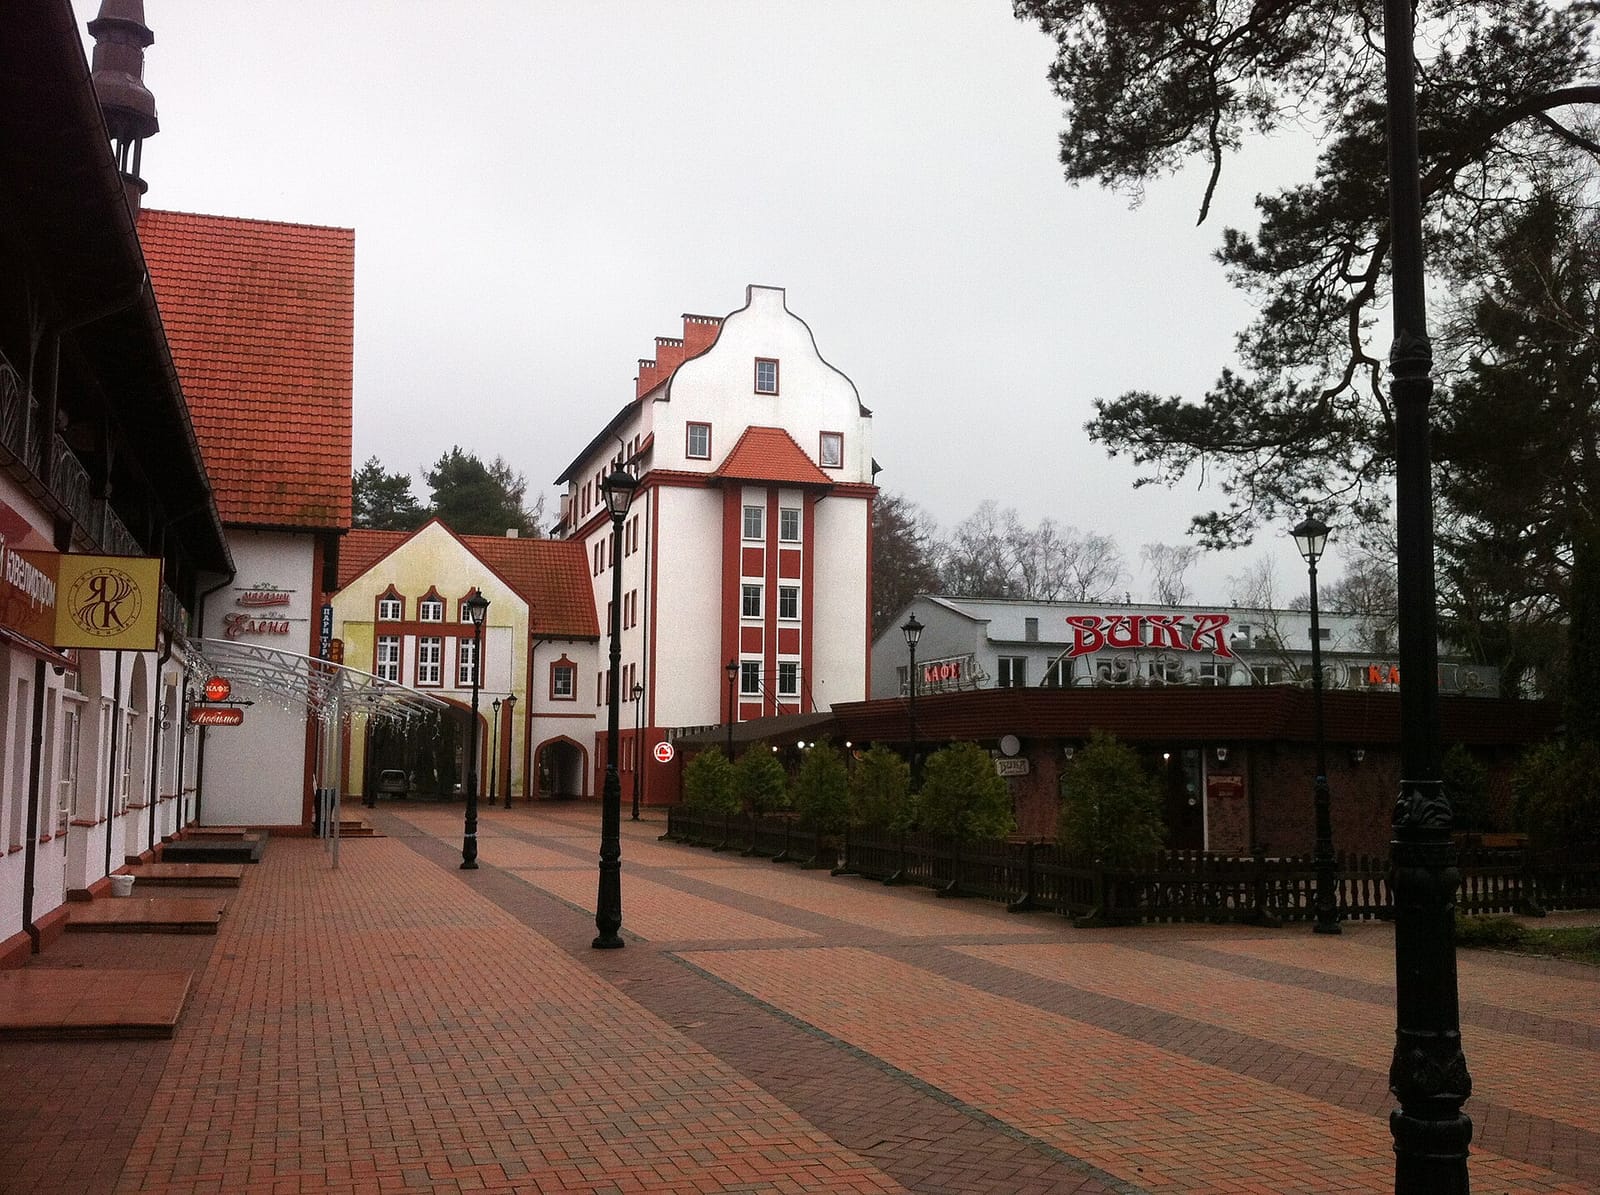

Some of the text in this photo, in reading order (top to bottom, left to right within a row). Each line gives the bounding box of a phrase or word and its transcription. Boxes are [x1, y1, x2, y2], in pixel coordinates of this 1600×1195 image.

[224, 612, 290, 639] Елена
[924, 662, 960, 682] КАФЕ
[206, 685, 230, 693] КАФЕ
